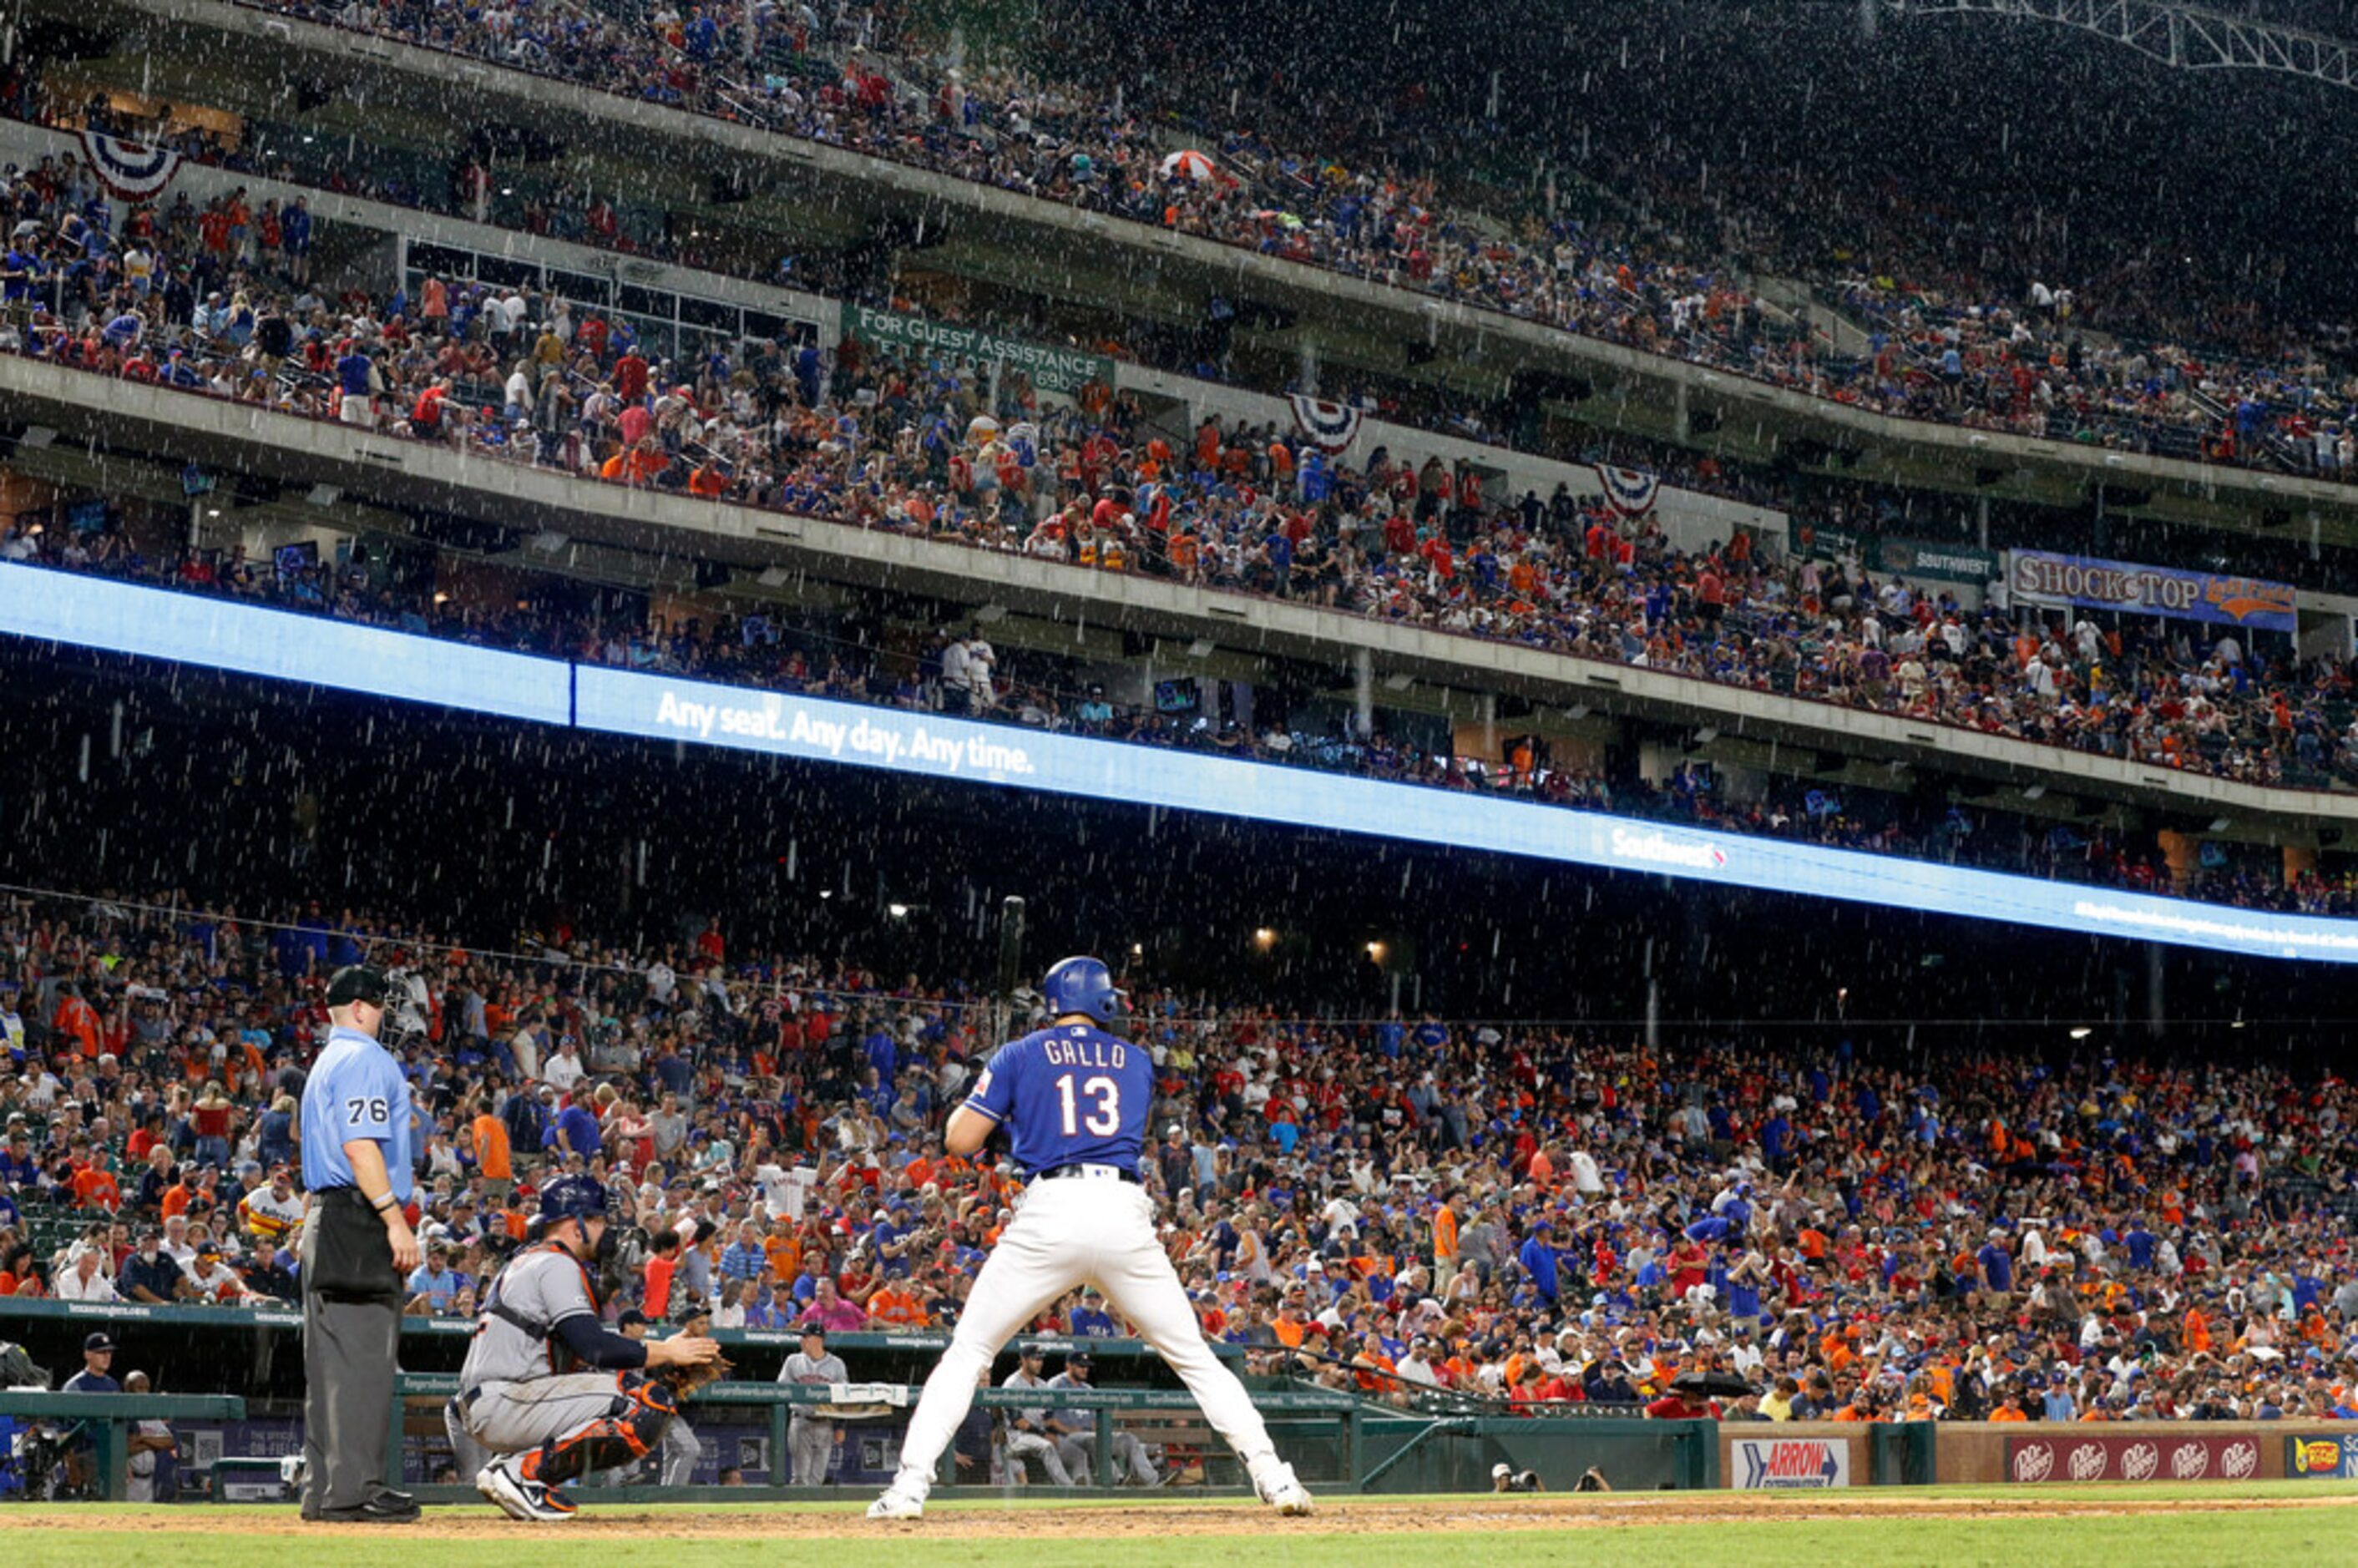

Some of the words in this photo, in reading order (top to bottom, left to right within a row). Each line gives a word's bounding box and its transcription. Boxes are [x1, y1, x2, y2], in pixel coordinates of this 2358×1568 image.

[860, 308, 903, 335] FOR
[907, 318, 975, 350] GUEST
[979, 336, 1096, 376] ASSISTANCE
[1917, 552, 1991, 574] SOUTHWEST
[2017, 556, 2123, 601] SHOCK
[2139, 574, 2200, 609] TOP
[656, 692, 716, 736] Any
[721, 706, 786, 740] seat.
[790, 711, 846, 755] Any
[850, 718, 906, 763] day.
[910, 727, 967, 771] Any
[969, 735, 1035, 775] time.
[1044, 1039, 1126, 1070] GALLO
[347, 1097, 388, 1125] 76
[1056, 1073, 1121, 1137] 13
[1765, 1442, 1824, 1477] ARROW
